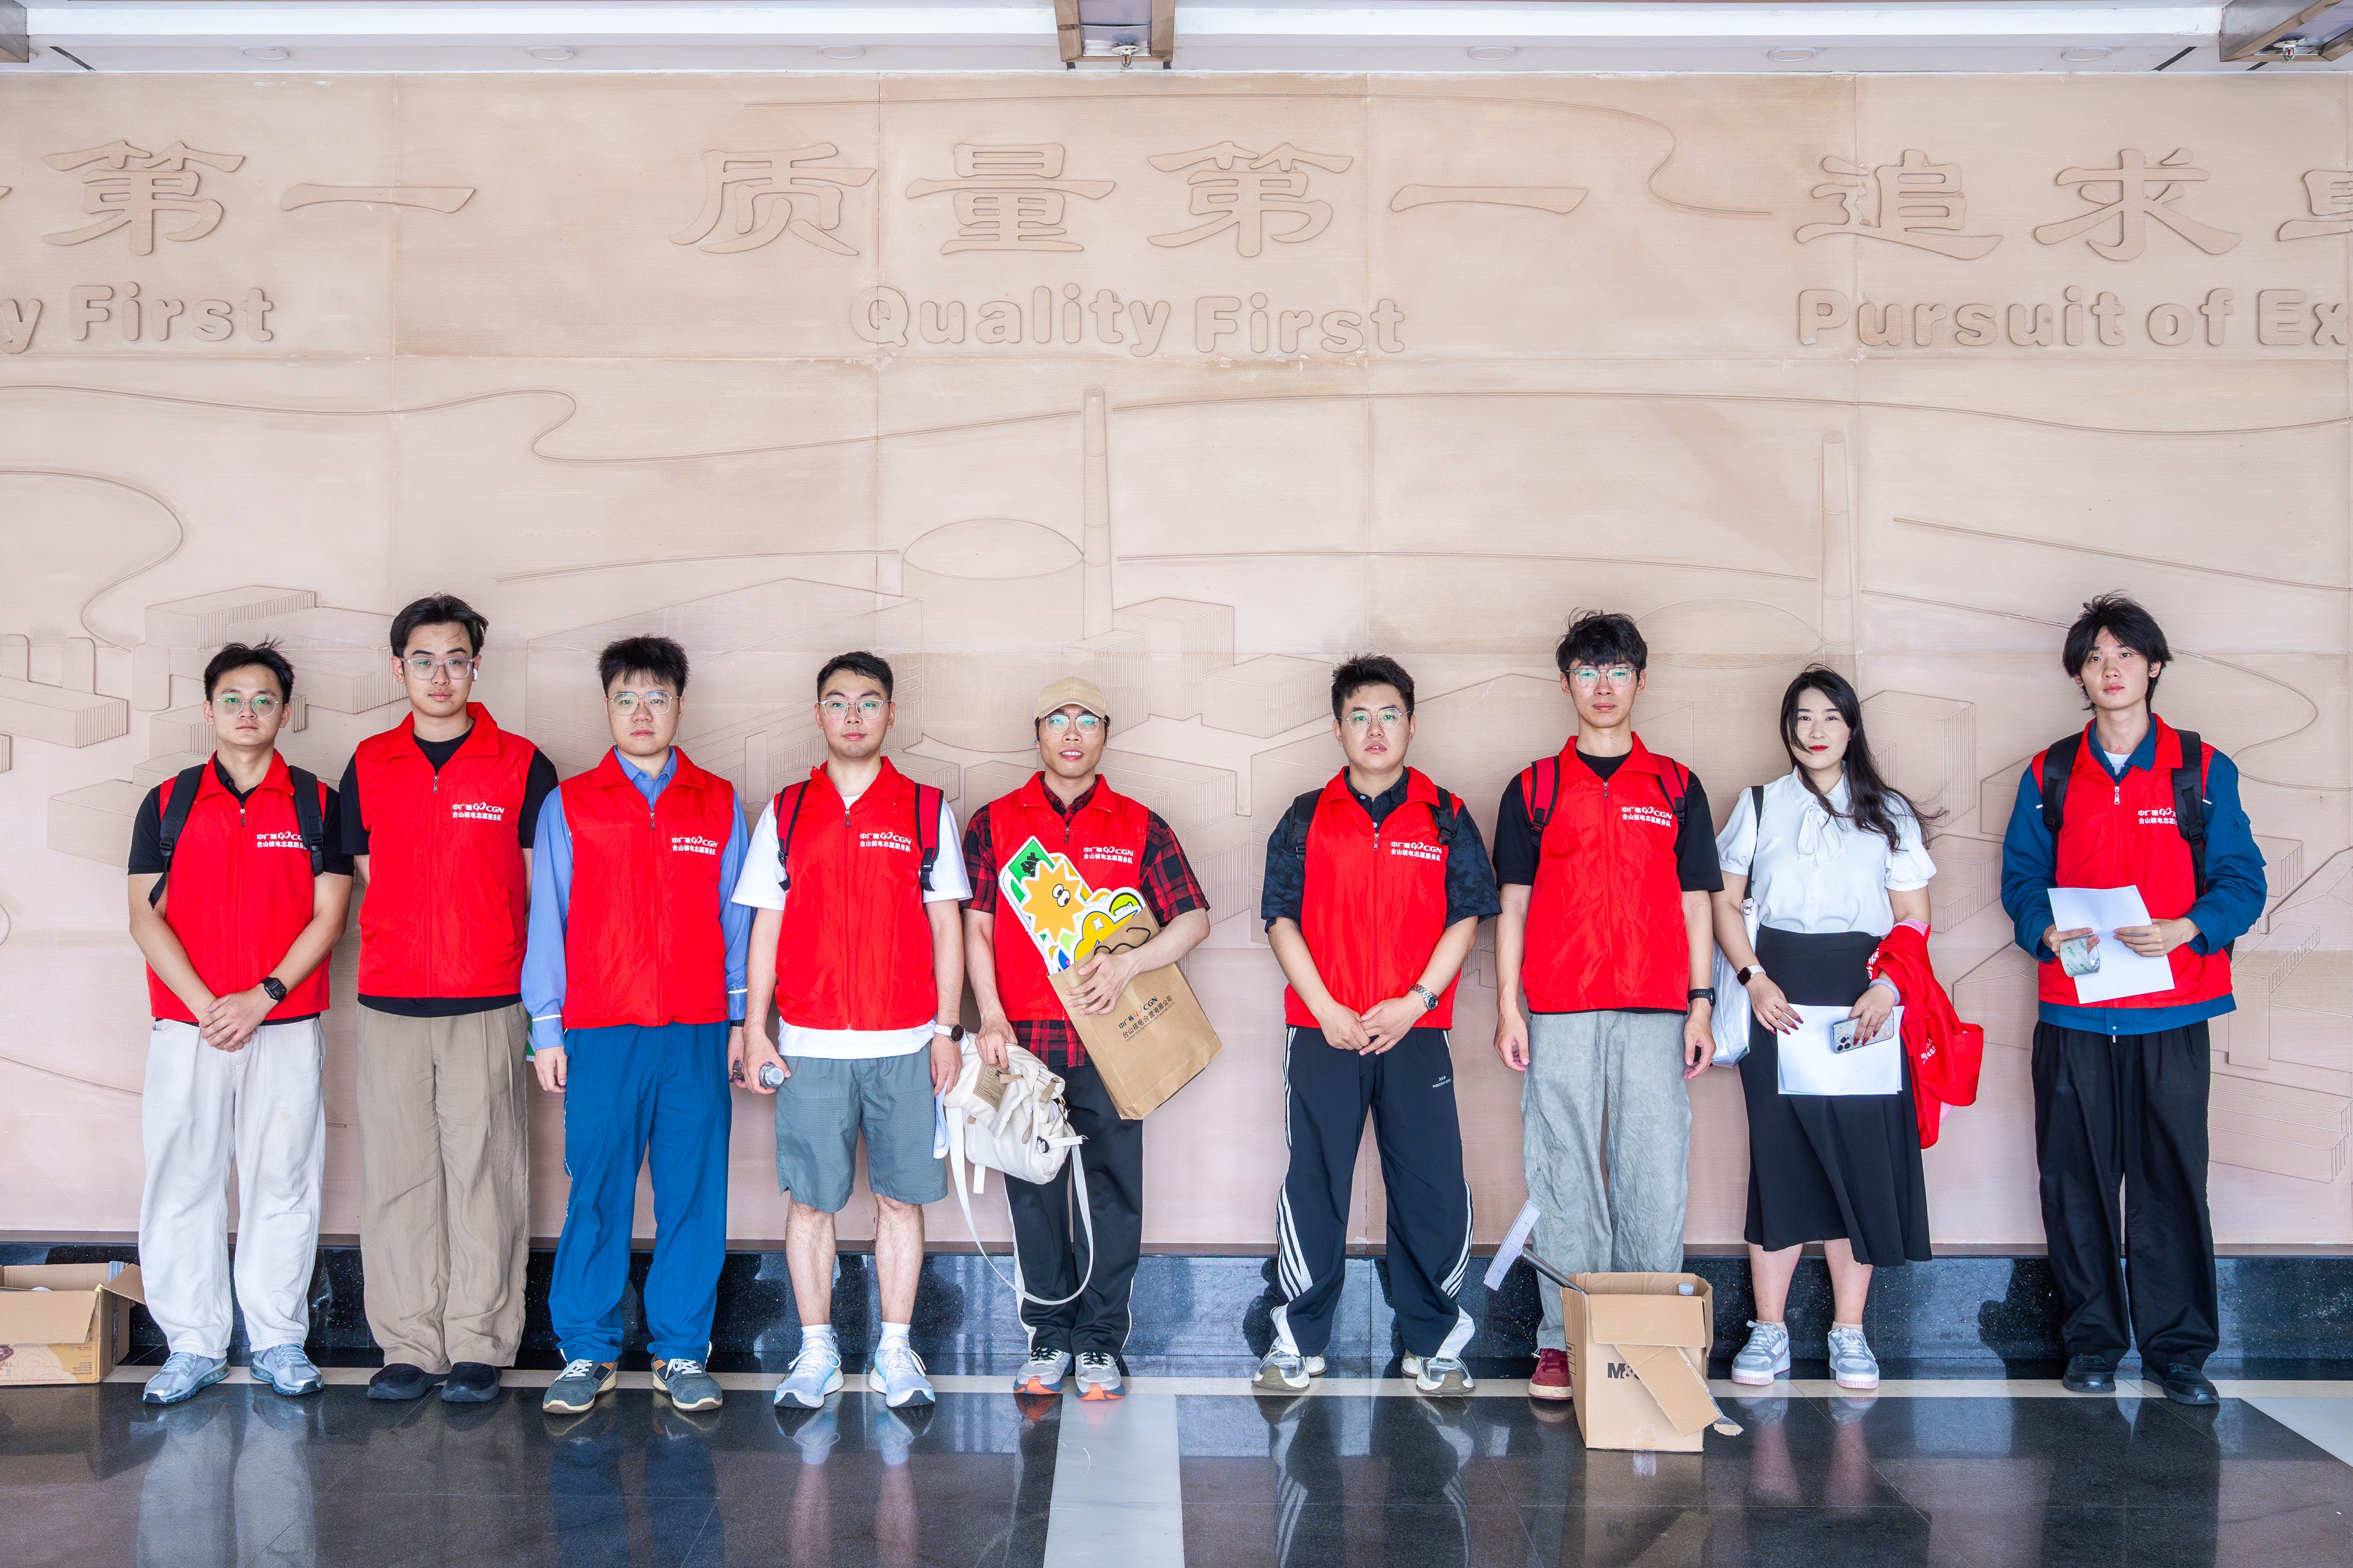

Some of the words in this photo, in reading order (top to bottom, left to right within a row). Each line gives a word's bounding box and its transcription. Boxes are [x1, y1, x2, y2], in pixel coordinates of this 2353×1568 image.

[0, 140, 477, 256] 第一
[669, 141, 1589, 258] 质量第一
[69, 281, 274, 342] First
[1796, 286, 2126, 347] Pursuit
[2147, 288, 2235, 346] of
[850, 283, 1171, 357] Quality
[1196, 293, 1405, 354] First
[486, 806, 505, 814] CGN
[1653, 810, 1672, 819] CGN
[2138, 817, 2178, 825] 台山核电志愿
[702, 839, 719, 848] CGN
[893, 835, 912, 845] CGN
[1115, 848, 1134, 857] CGN
[1423, 845, 1442, 854] CGN
[1143, 996, 1158, 1010] CGN
[1122, 995, 1173, 1039] 台山核电合营有限公司
[1607, 1362, 1640, 1380] M&
